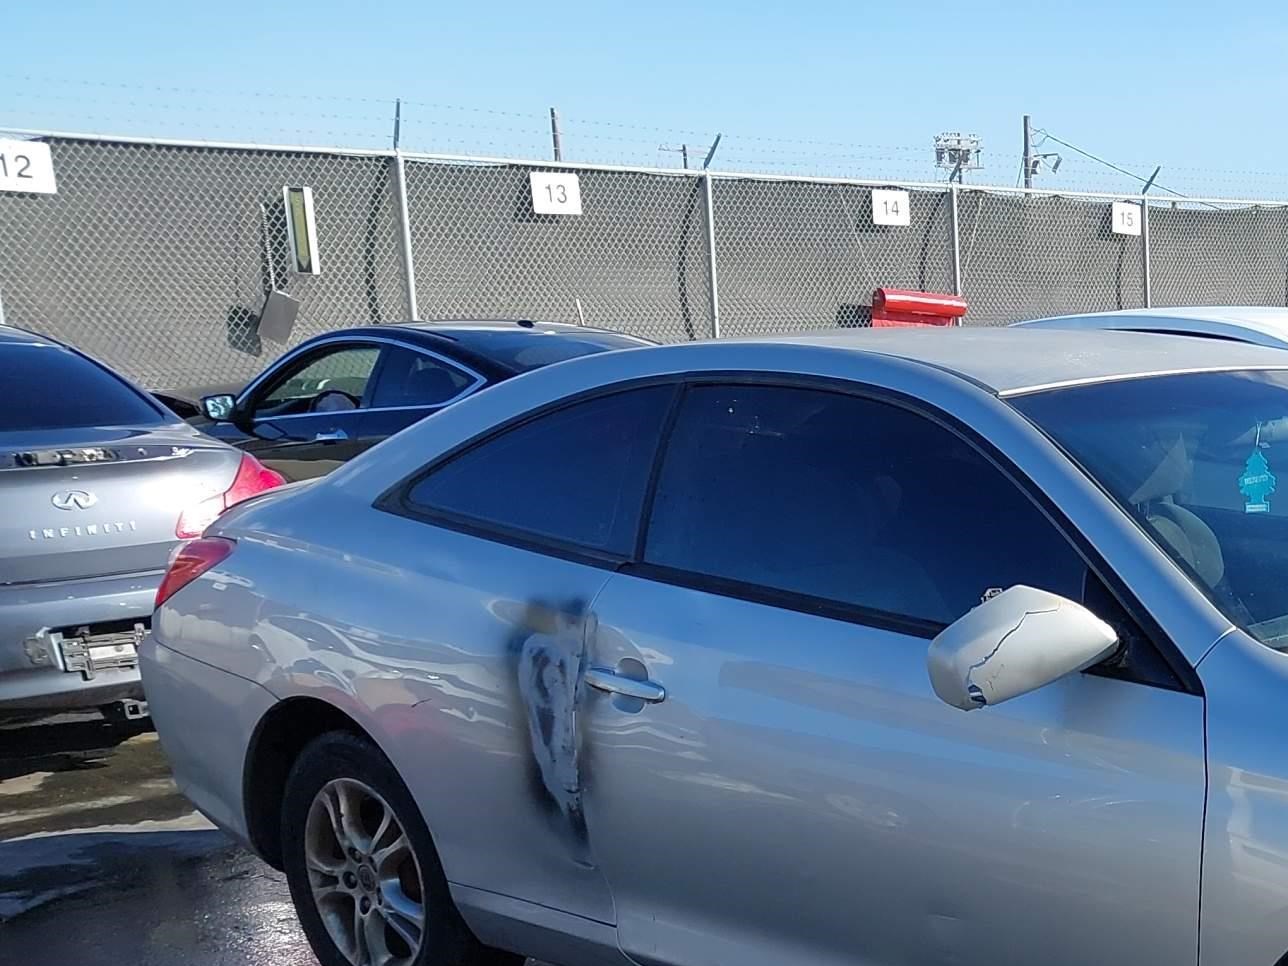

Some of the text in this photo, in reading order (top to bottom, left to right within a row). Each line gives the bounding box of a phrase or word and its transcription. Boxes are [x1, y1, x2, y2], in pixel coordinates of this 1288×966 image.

[0, 153, 33, 178] 12
[545, 184, 567, 203] 13
[883, 200, 899, 216] 14
[1120, 212, 1133, 227] 15
[28, 520, 137, 540] INFINITI
